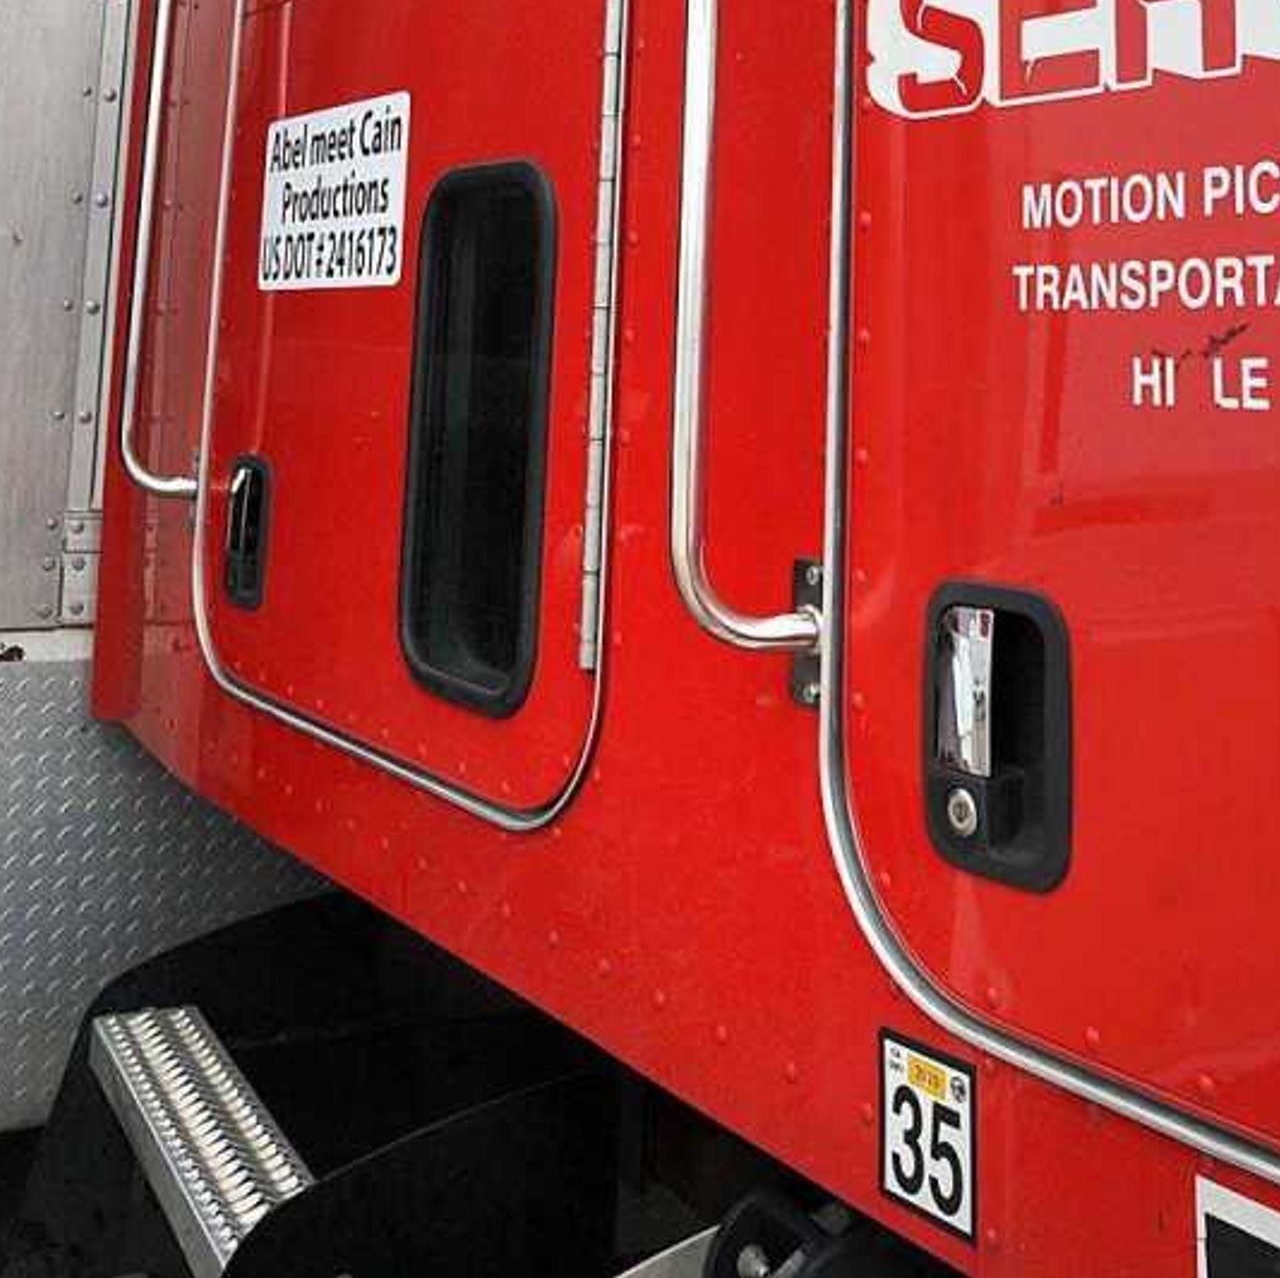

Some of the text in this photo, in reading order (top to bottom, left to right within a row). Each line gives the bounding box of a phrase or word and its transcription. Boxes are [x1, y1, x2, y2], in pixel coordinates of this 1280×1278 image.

[270, 105, 401, 172] Abel meet Cain
[281, 169, 389, 224] Productions
[1022, 170, 1186, 229] MOTION
[892, 1084, 964, 1217] 35
